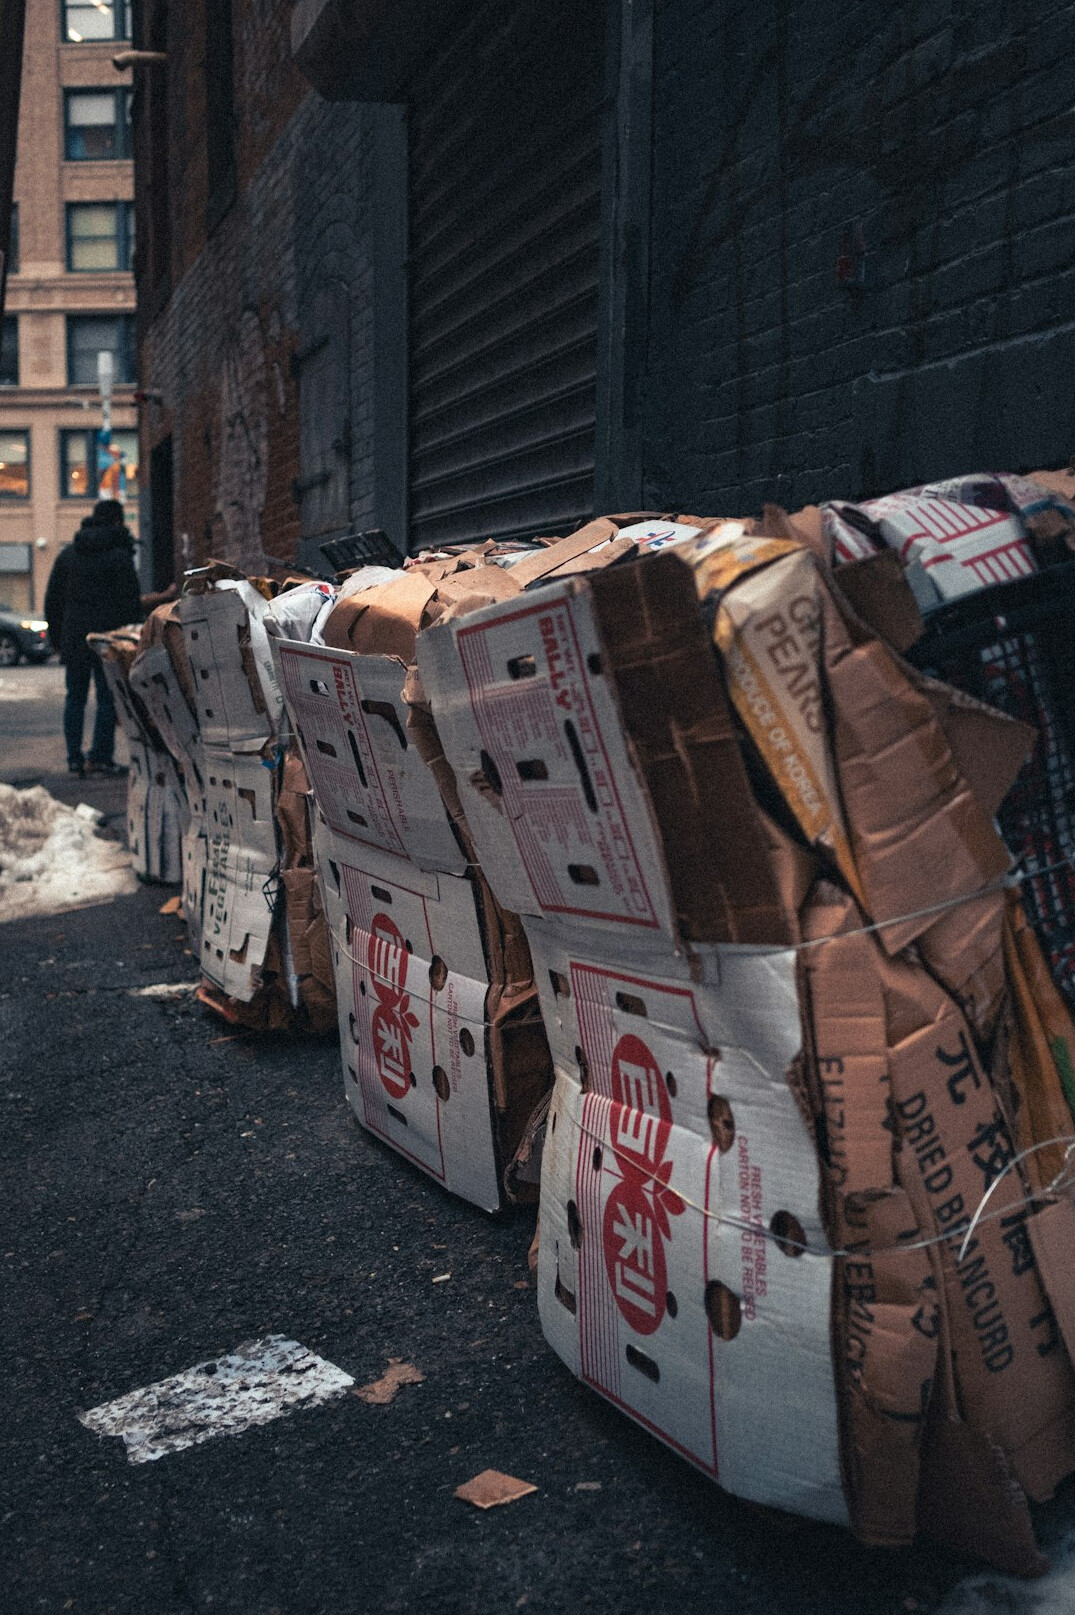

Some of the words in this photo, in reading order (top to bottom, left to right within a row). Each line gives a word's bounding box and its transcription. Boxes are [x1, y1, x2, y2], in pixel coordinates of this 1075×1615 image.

[538, 616, 572, 711] BALLY
[332, 666, 354, 726] BALLY
[386, 769, 410, 832] PERISHABLE
[738, 1136, 750, 1190] CARTON
[751, 1166, 762, 1209] FRESH
[741, 1246, 753, 1263] BE
[753, 1213, 767, 1296] VGETABLES
[900, 1091, 953, 1195] DRIED
[937, 1195, 1014, 1374] BEANCURD
